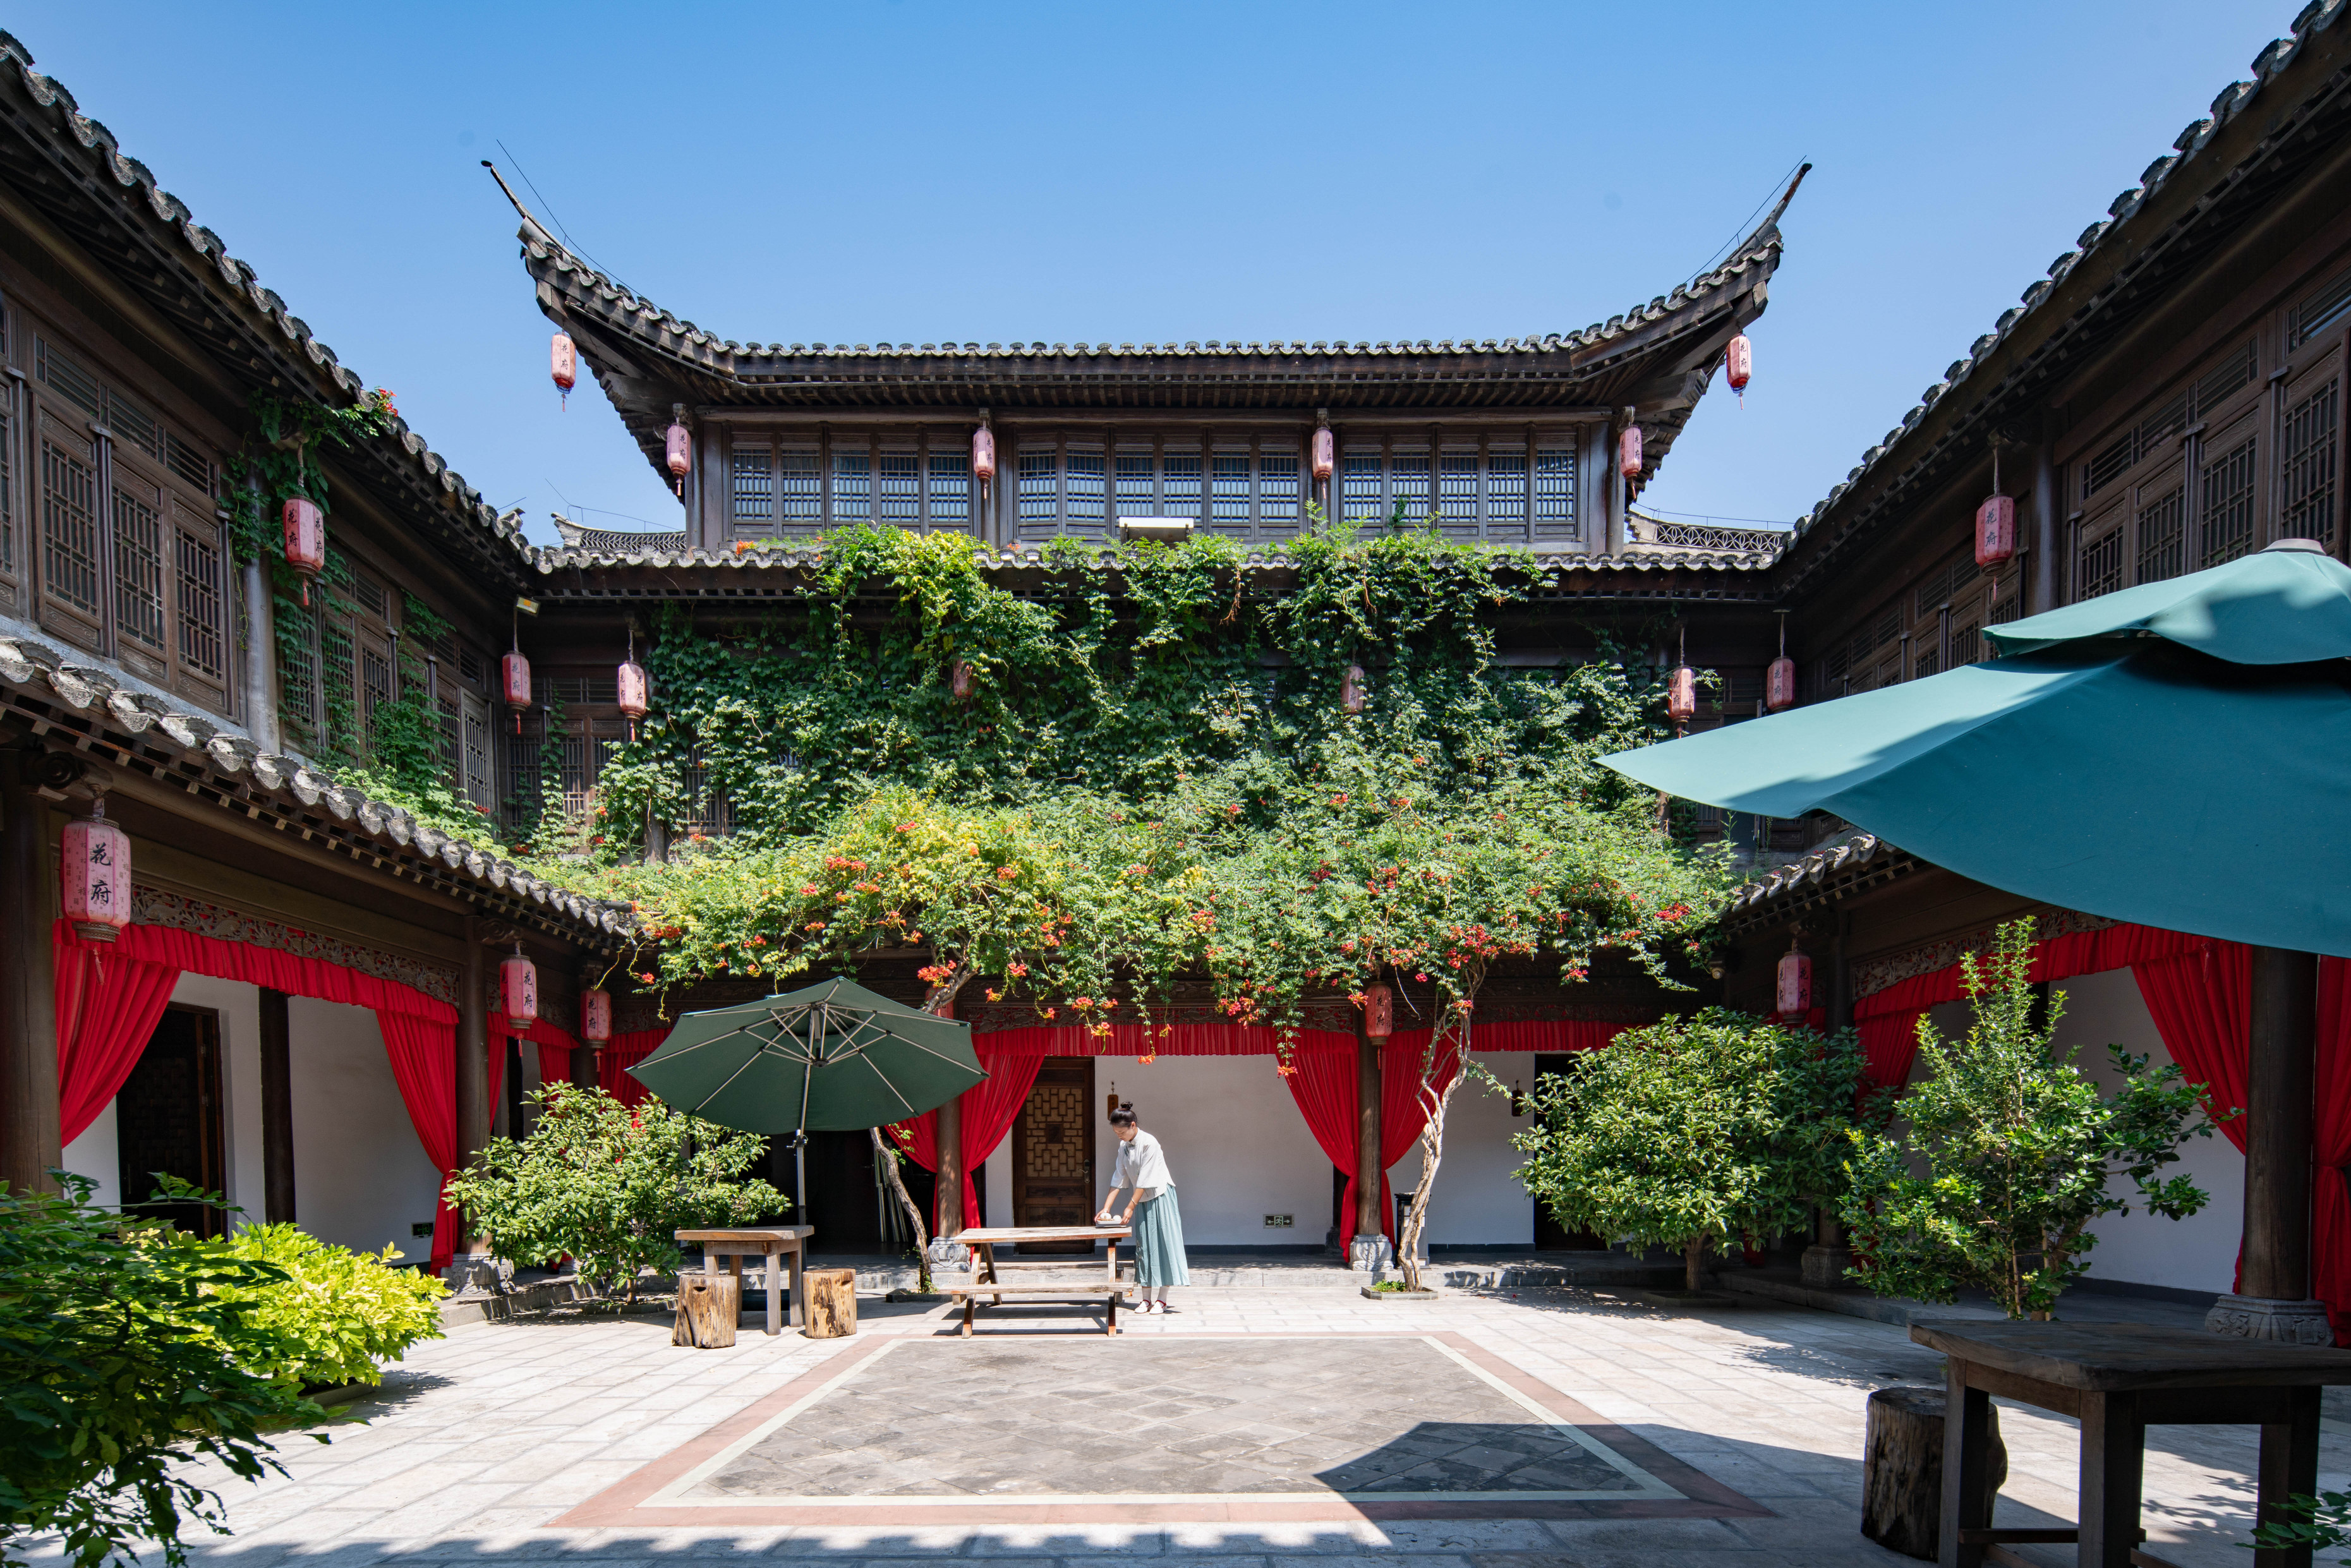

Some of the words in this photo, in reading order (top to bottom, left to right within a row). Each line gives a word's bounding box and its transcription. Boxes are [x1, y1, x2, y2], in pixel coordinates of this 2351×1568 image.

[561, 342, 569, 370] 花府
[1740, 342, 1747, 368] 花府
[679, 434, 686, 459] 花府
[986, 437, 992, 463] 花府
[1327, 437, 1332, 462] 花府
[1635, 434, 1640, 459] 花府
[287, 509, 298, 546] 花府
[315, 517, 322, 556] 花府
[1986, 508, 1997, 547] 花府
[512, 662, 520, 691] 花府
[637, 674, 643, 703] 花府
[1774, 667, 1782, 696] 花府
[1672, 677, 1681, 706] 花府
[90, 842, 112, 904] 花府
[524, 970, 533, 1008] 花府
[1779, 967, 1784, 1003] 花府
[1799, 966, 1808, 1001] 花府
[588, 998, 596, 1029] 花府
[1376, 994, 1384, 1026] 花府
